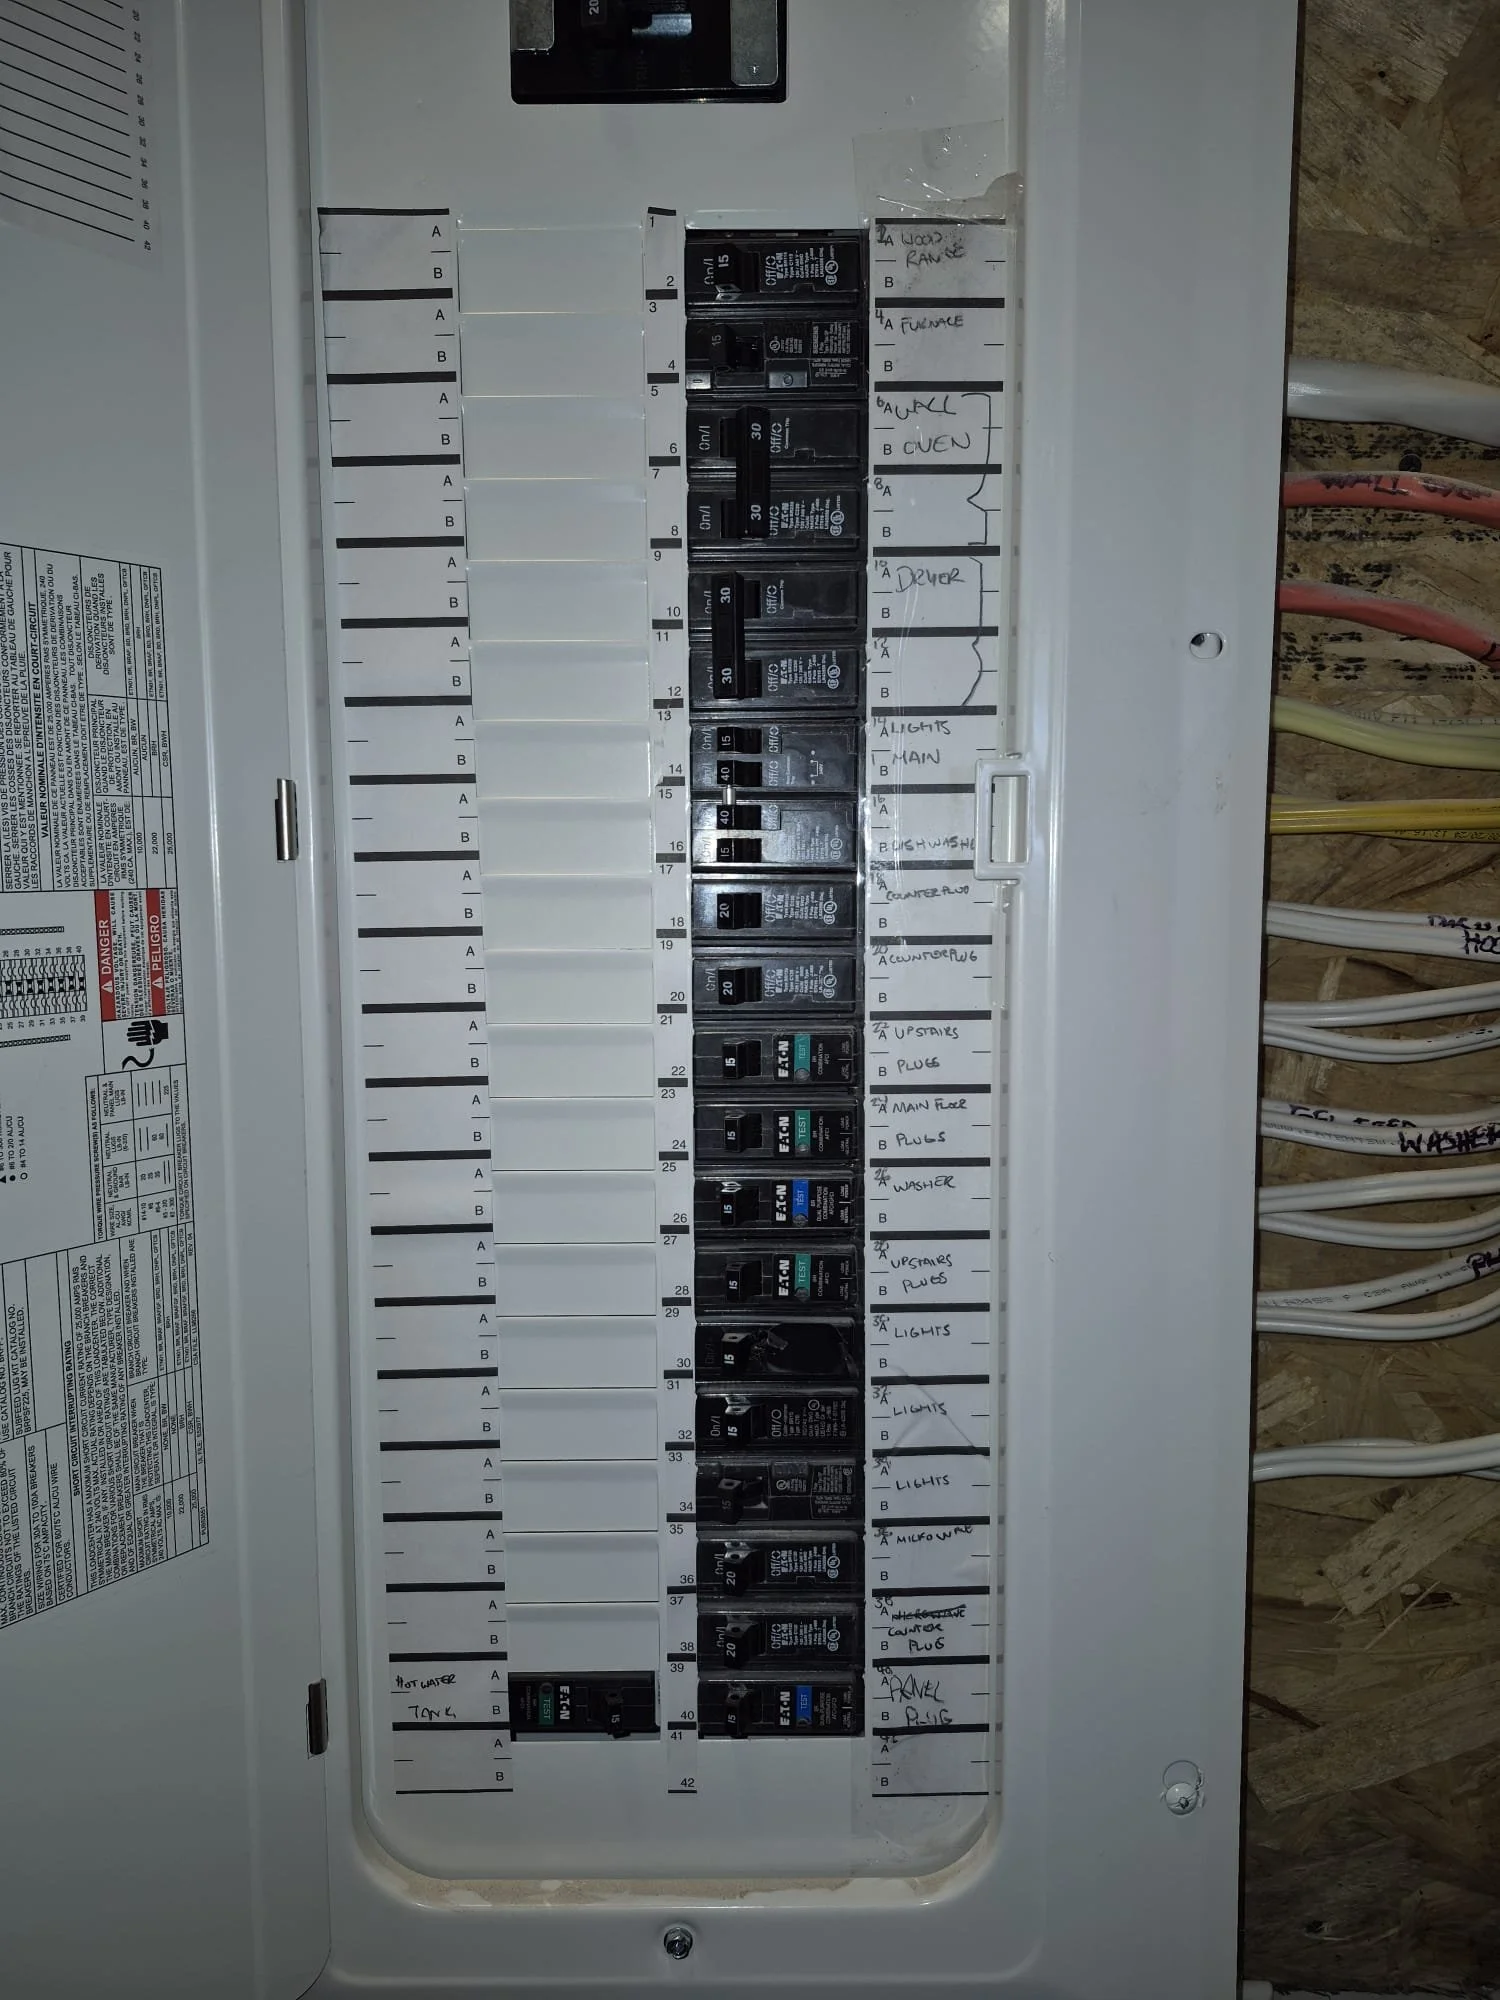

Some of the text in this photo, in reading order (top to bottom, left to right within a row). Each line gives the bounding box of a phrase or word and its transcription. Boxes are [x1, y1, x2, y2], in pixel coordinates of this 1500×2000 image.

[649, 215, 655, 229] 1
[431, 224, 442, 238] A
[718, 254, 729, 268] 15
[666, 275, 675, 288] 2
[884, 276, 894, 289] B
[648, 301, 658, 314] 3
[901, 315, 964, 335] FURNACE
[667, 359, 676, 371] 4
[650, 384, 659, 397] 5
[751, 423, 762, 440] 30
[669, 442, 678, 455] 6
[903, 432, 971, 455] OVEN
[751, 504, 762, 521] 30
[445, 515, 455, 528] B
[670, 524, 679, 537] 8
[653, 549, 662, 562] 9
[720, 586, 731, 604] 30
[666, 605, 681, 618] 10
[28, 602, 39, 675] COURT-CIRCUIT
[722, 667, 732, 685] 30
[32, 678, 40, 690] EN
[667, 685, 682, 697] 12
[657, 709, 672, 722] 13
[891, 719, 951, 735] LIGHTS
[722, 735, 731, 747] 15
[37, 752, 47, 798] NOMINALE
[721, 767, 730, 782] 40
[657, 788, 673, 800] 15
[39, 801, 49, 838] VALEUR
[720, 810, 730, 825] 40
[668, 840, 685, 852] 16
[720, 843, 730, 856] 15
[720, 902, 730, 918] 20
[669, 916, 685, 928] 18
[99, 919, 111, 974] DANGER
[150, 915, 162, 971] PELIGRO
[465, 945, 476, 957] A
[723, 981, 733, 996] 20
[669, 991, 685, 1002] 20
[878, 992, 888, 1004] B
[894, 1026, 960, 1040] UPSTAIRS
[726, 1056, 735, 1068] 15
[671, 1065, 686, 1077] 22
[660, 1088, 676, 1099] 23
[892, 1099, 930, 1114] MAIN
[798, 1116, 806, 1139] TEST
[727, 1131, 735, 1141] 15
[661, 1161, 677, 1173] 25
[893, 1175, 957, 1193] WASHER
[724, 1203, 733, 1214] 15
[891, 1253, 953, 1270] UPSTAIRS
[798, 1261, 806, 1283] TEST
[674, 1284, 689, 1296] 28
[730, 1279, 738, 1290] 15
[664, 1307, 680, 1318] 29
[894, 1324, 951, 1339] LIGHTS
[65, 1341, 73, 1371] RATING
[725, 1353, 734, 1365] 15
[666, 1379, 680, 1391] 31
[893, 1402, 948, 1417] LIGHTS
[677, 1429, 693, 1440] 32
[728, 1424, 738, 1437] 15
[70, 1434, 79, 1466] CIRCUIT
[72, 1468, 81, 1496] SHORT
[895, 1474, 950, 1491] LIGHTS
[679, 1501, 694, 1512] 34
[669, 1523, 684, 1535] 35
[726, 1571, 736, 1587] 20
[669, 1595, 685, 1606] 37
[679, 1641, 695, 1652] 38
[727, 1642, 737, 1658] 20
[680, 1710, 695, 1720] 40
[727, 1713, 736, 1725] 15
[495, 1771, 505, 1782] B
[679, 1777, 695, 1788] 42
